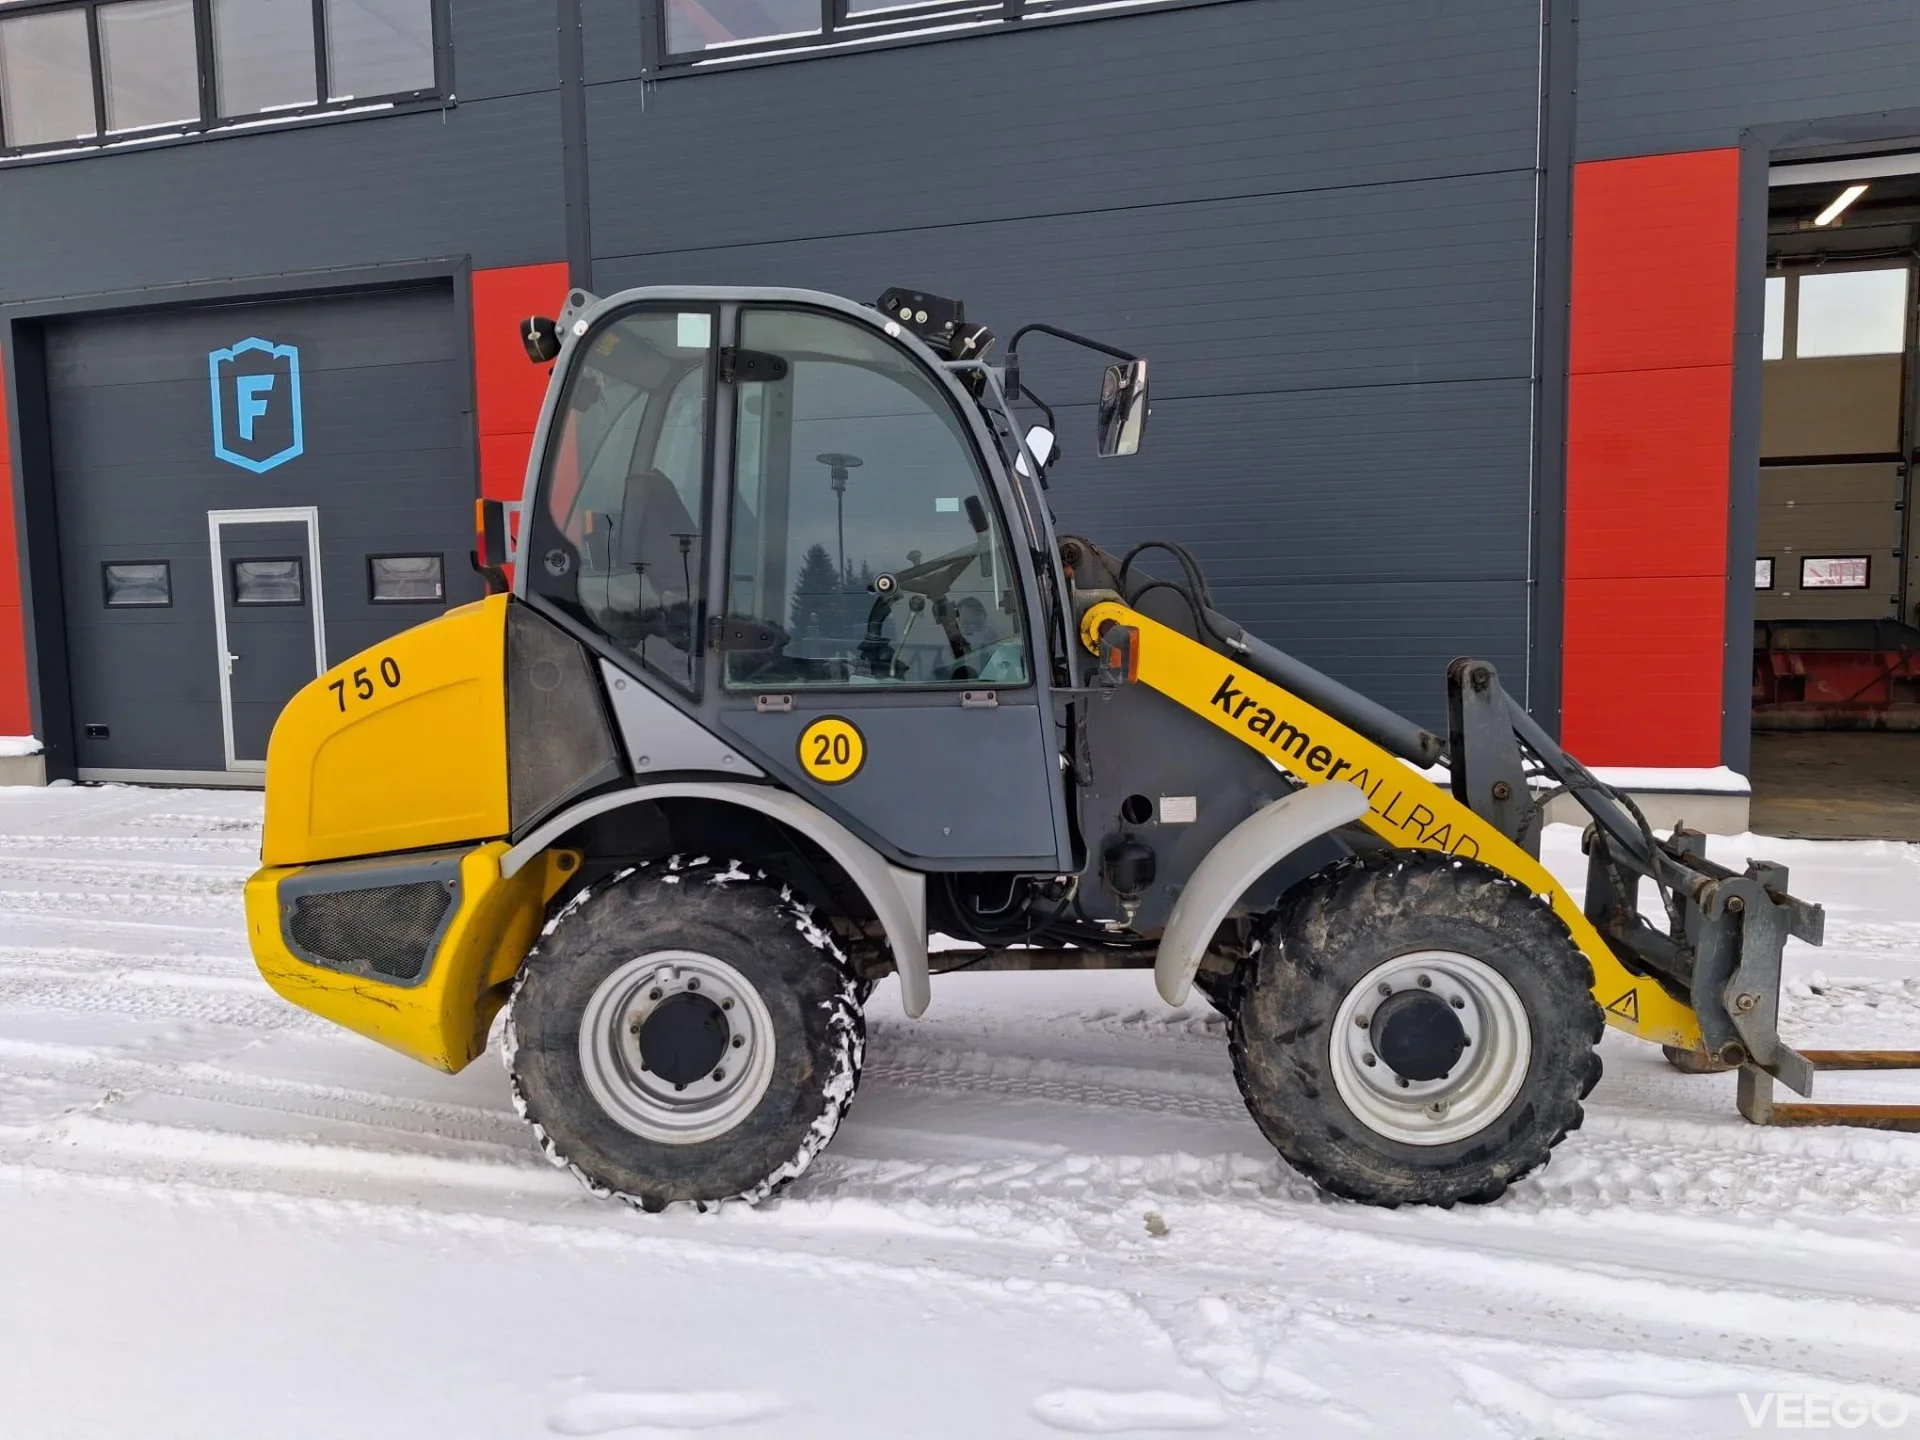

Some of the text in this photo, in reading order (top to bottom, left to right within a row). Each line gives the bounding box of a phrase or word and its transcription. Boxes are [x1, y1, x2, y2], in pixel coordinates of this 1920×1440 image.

[236, 373, 275, 441] F
[328, 656, 401, 713] 750
[813, 733, 850, 766] 20
[1209, 673, 1352, 781] kramer
